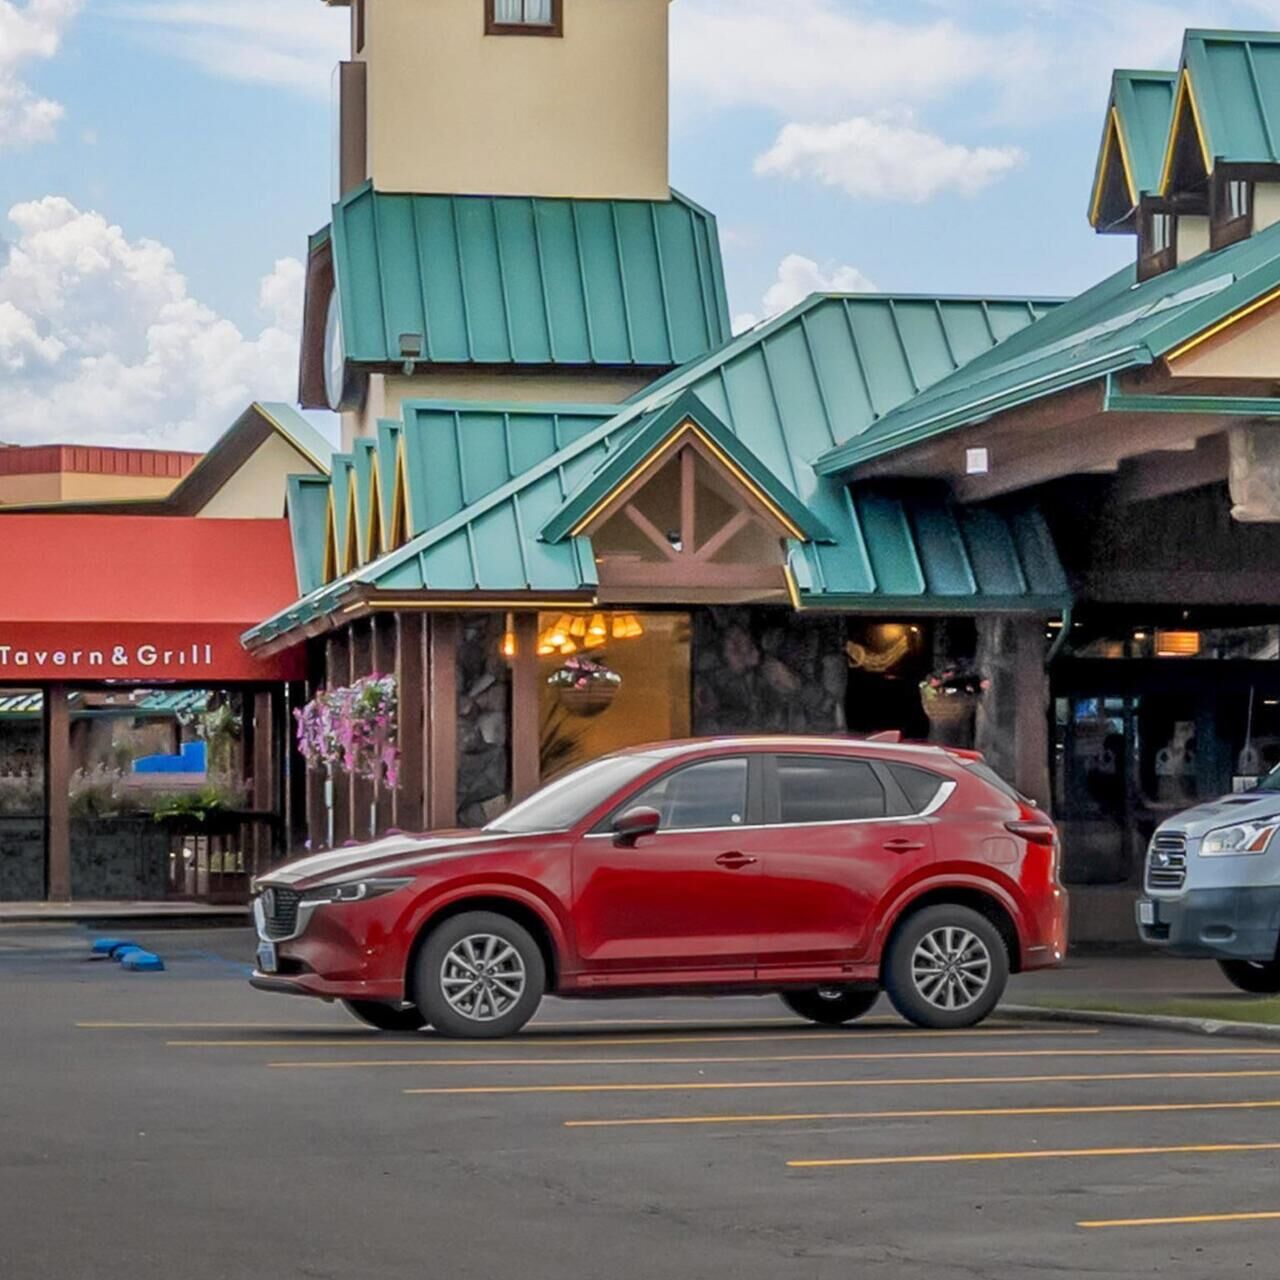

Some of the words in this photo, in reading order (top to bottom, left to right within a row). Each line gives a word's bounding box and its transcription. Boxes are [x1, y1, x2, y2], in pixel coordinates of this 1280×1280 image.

[0, 646, 103, 665] Tavern
[111, 646, 128, 665] &
[136, 645, 212, 665] Grill
